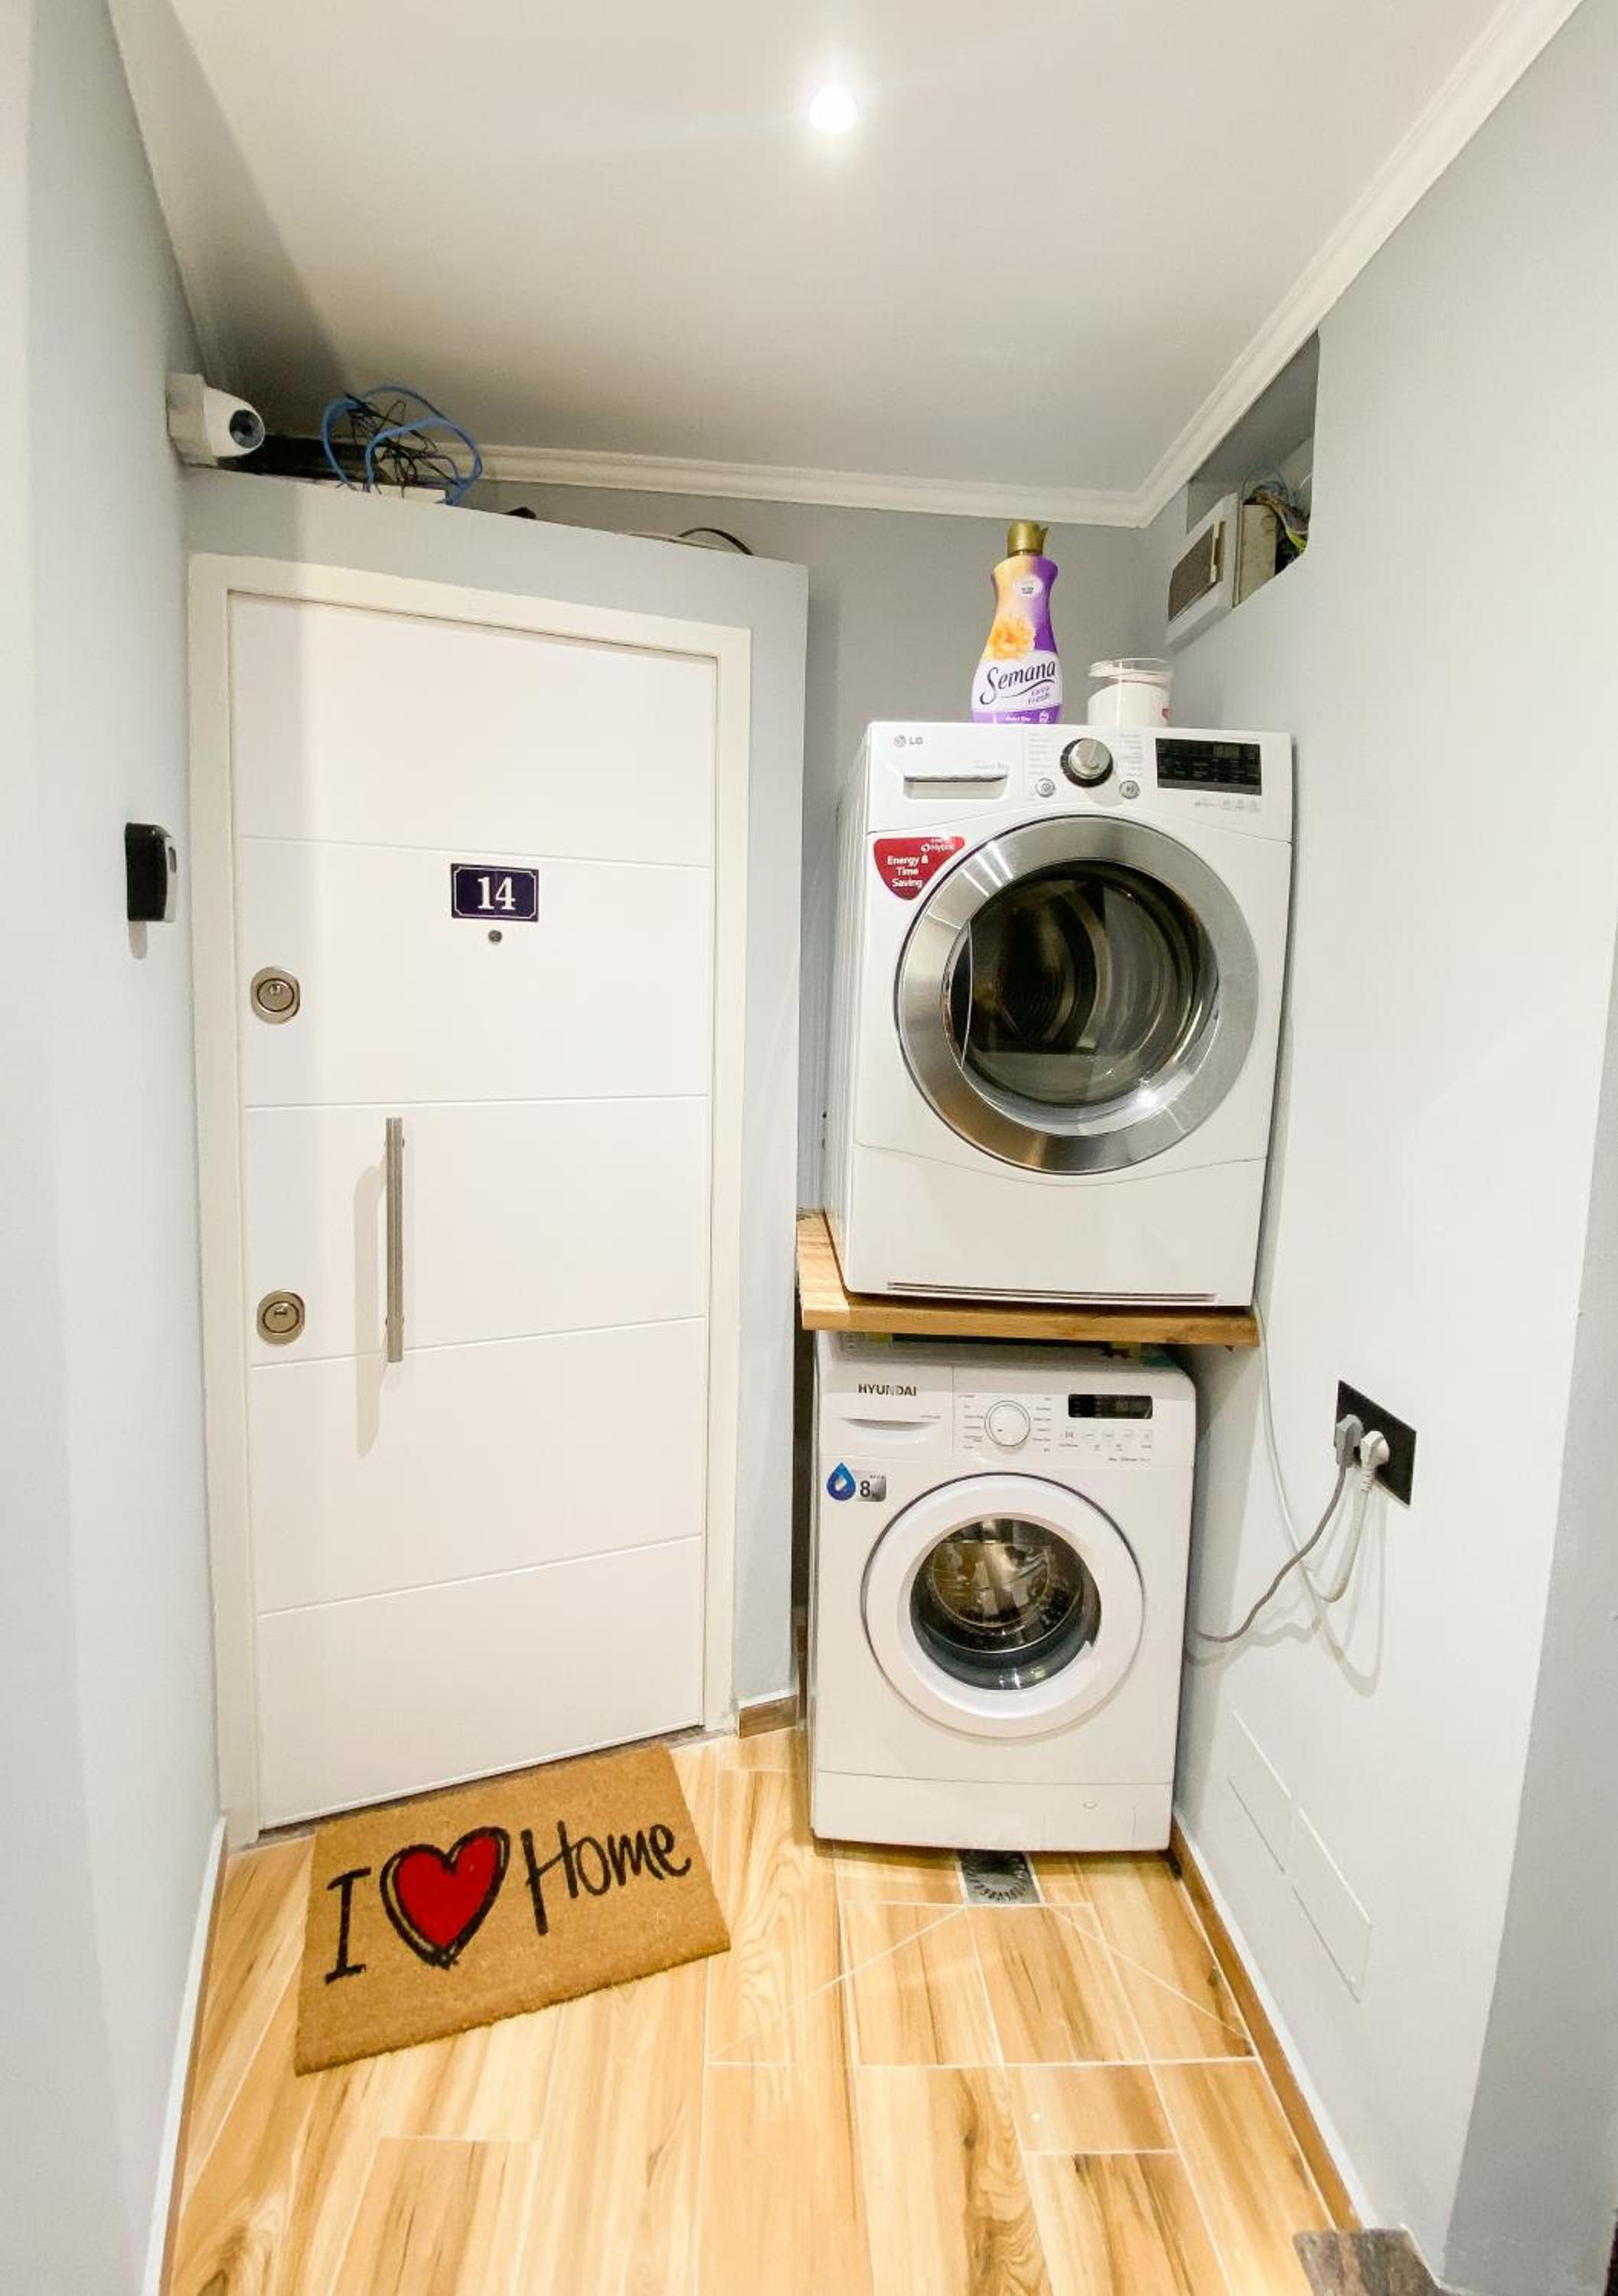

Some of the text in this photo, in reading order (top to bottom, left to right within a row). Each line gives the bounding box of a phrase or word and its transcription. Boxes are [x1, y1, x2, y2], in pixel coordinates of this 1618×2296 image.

[980, 660, 1055, 705] Semana
[908, 735, 923, 745] LG
[887, 856, 919, 867] Energy
[895, 866, 919, 876] Time
[892, 878, 922, 889] Saving
[477, 876, 517, 911] 14
[858, 1383, 917, 1397] HYUNDAI
[860, 1479, 871, 1498] 8
[325, 1820, 693, 1985] I Home
